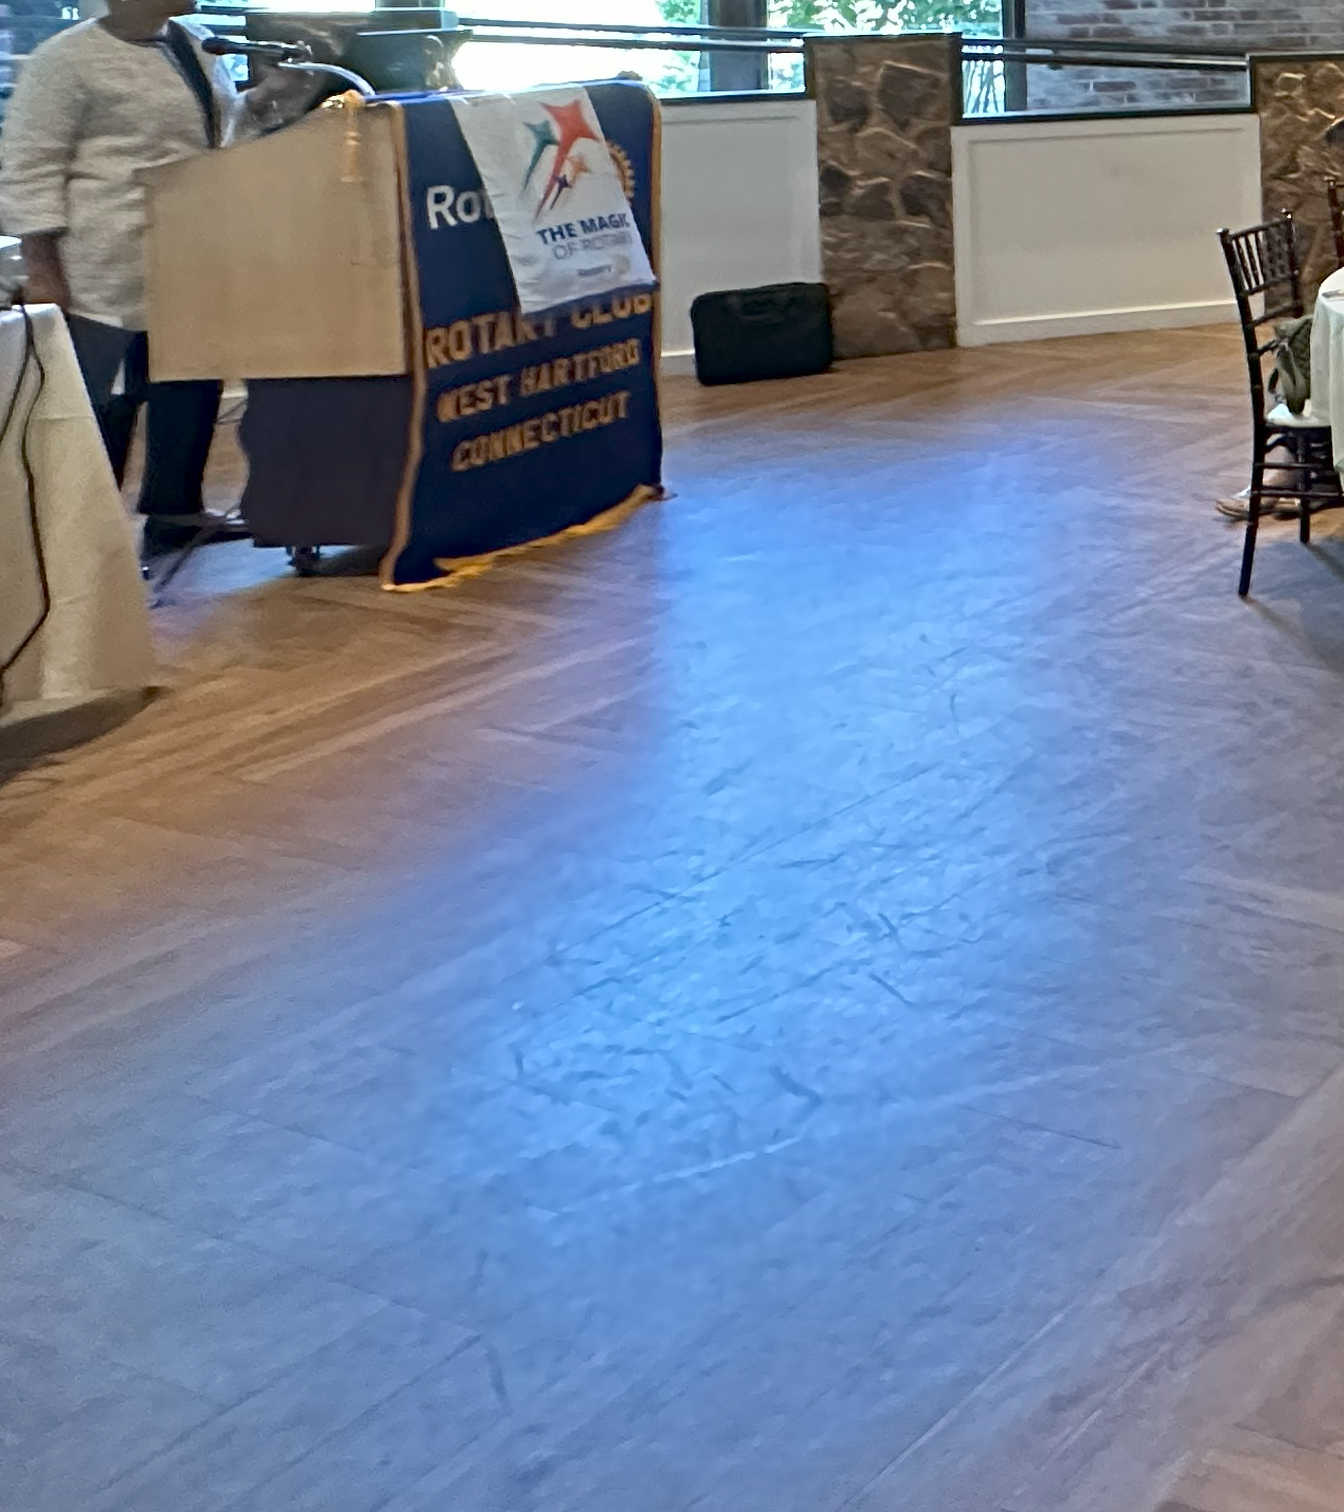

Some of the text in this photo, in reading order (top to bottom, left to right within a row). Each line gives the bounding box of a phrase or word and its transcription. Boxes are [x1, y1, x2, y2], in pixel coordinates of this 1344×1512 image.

[536, 223, 578, 245] THE
[552, 241, 578, 260] OF
[520, 337, 640, 397] HARTFORD
[451, 390, 632, 471] CONNECTICUT
